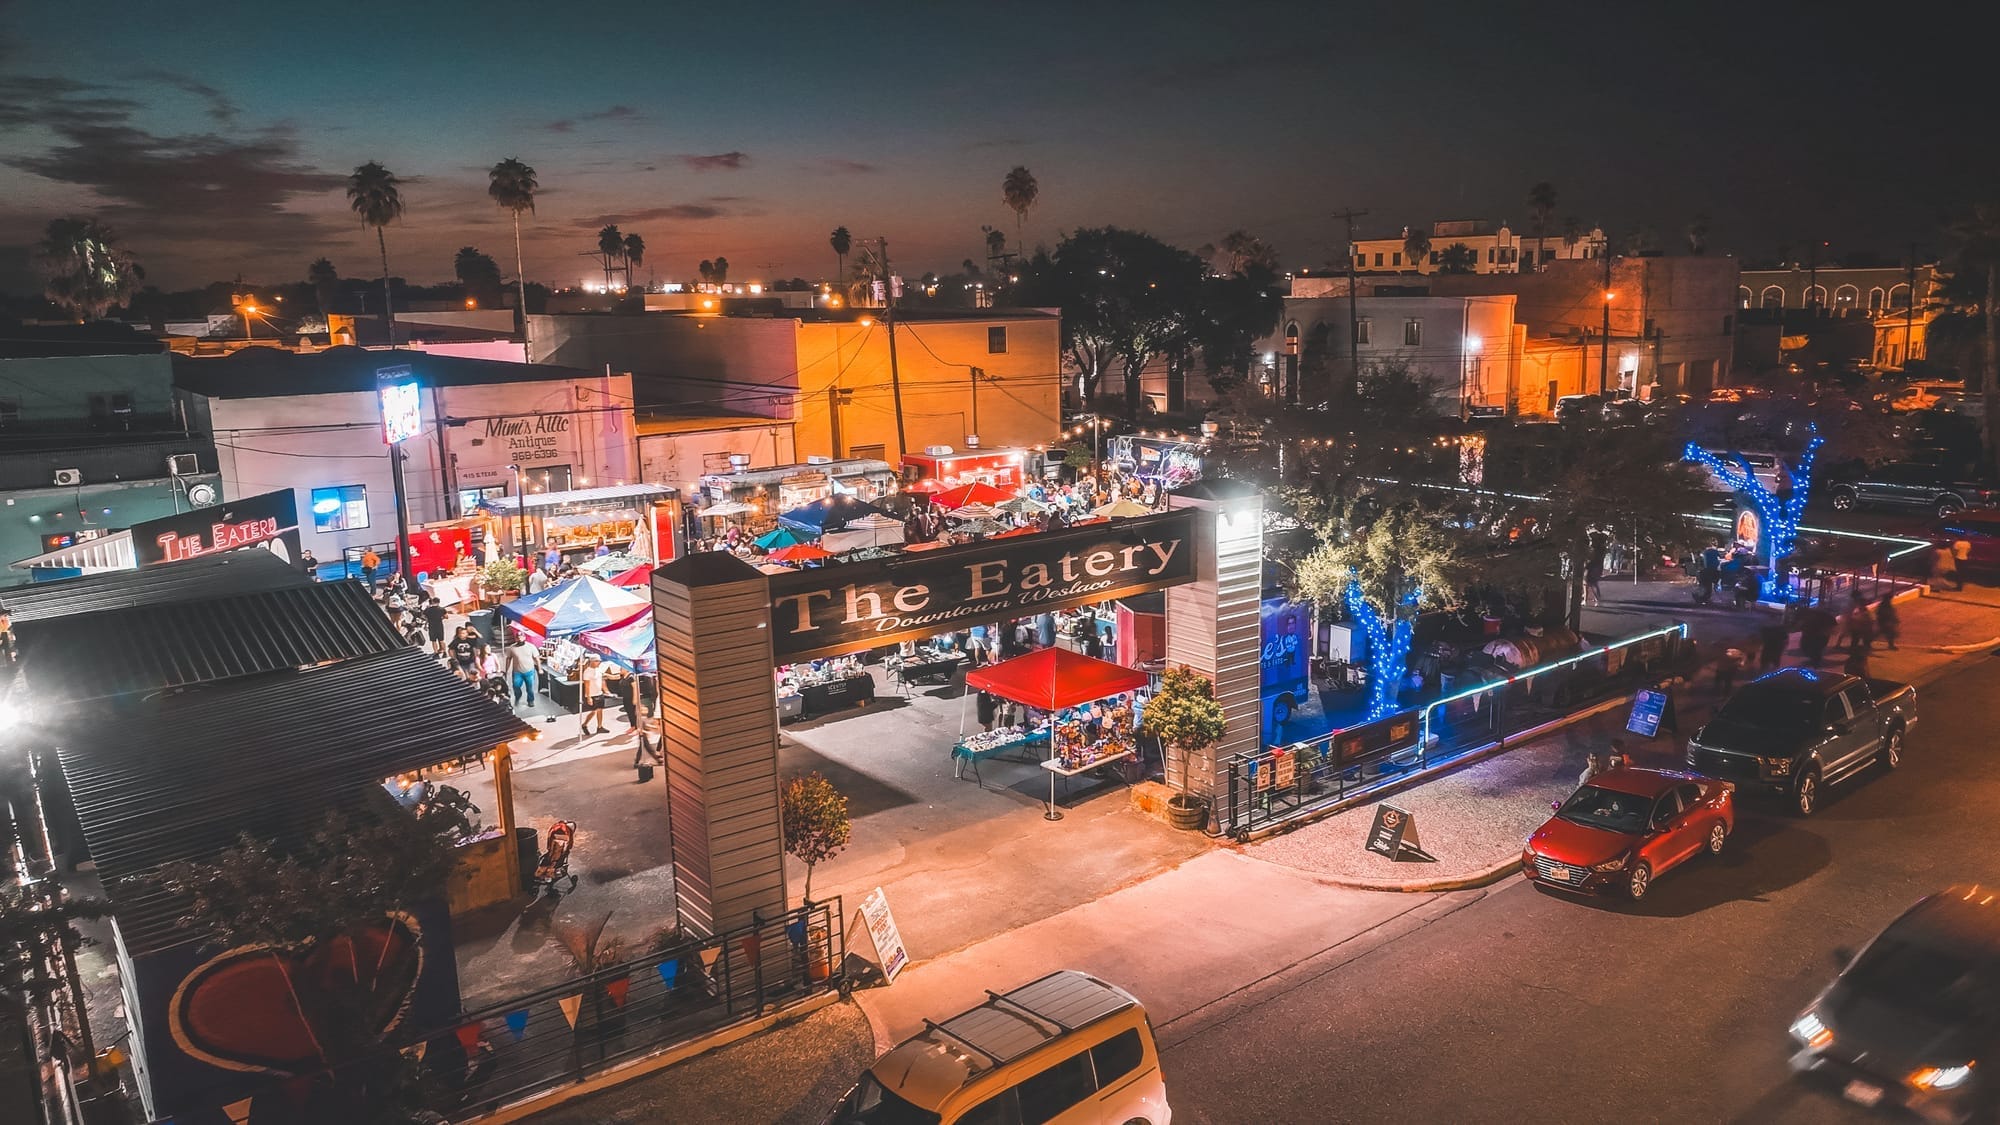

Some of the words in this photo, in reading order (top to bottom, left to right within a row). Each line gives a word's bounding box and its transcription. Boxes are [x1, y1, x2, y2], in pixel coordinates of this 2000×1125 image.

[485, 417, 531, 438] Mimi's
[535, 415, 569, 434] Attic
[508, 436, 557, 449] Antiques
[511, 449, 558, 461] 968-6396
[774, 583, 930, 635] The
[964, 539, 1182, 601] Eatery
[875, 600, 1011, 632] Downtown
[1018, 579, 1115, 605] Weslaco
